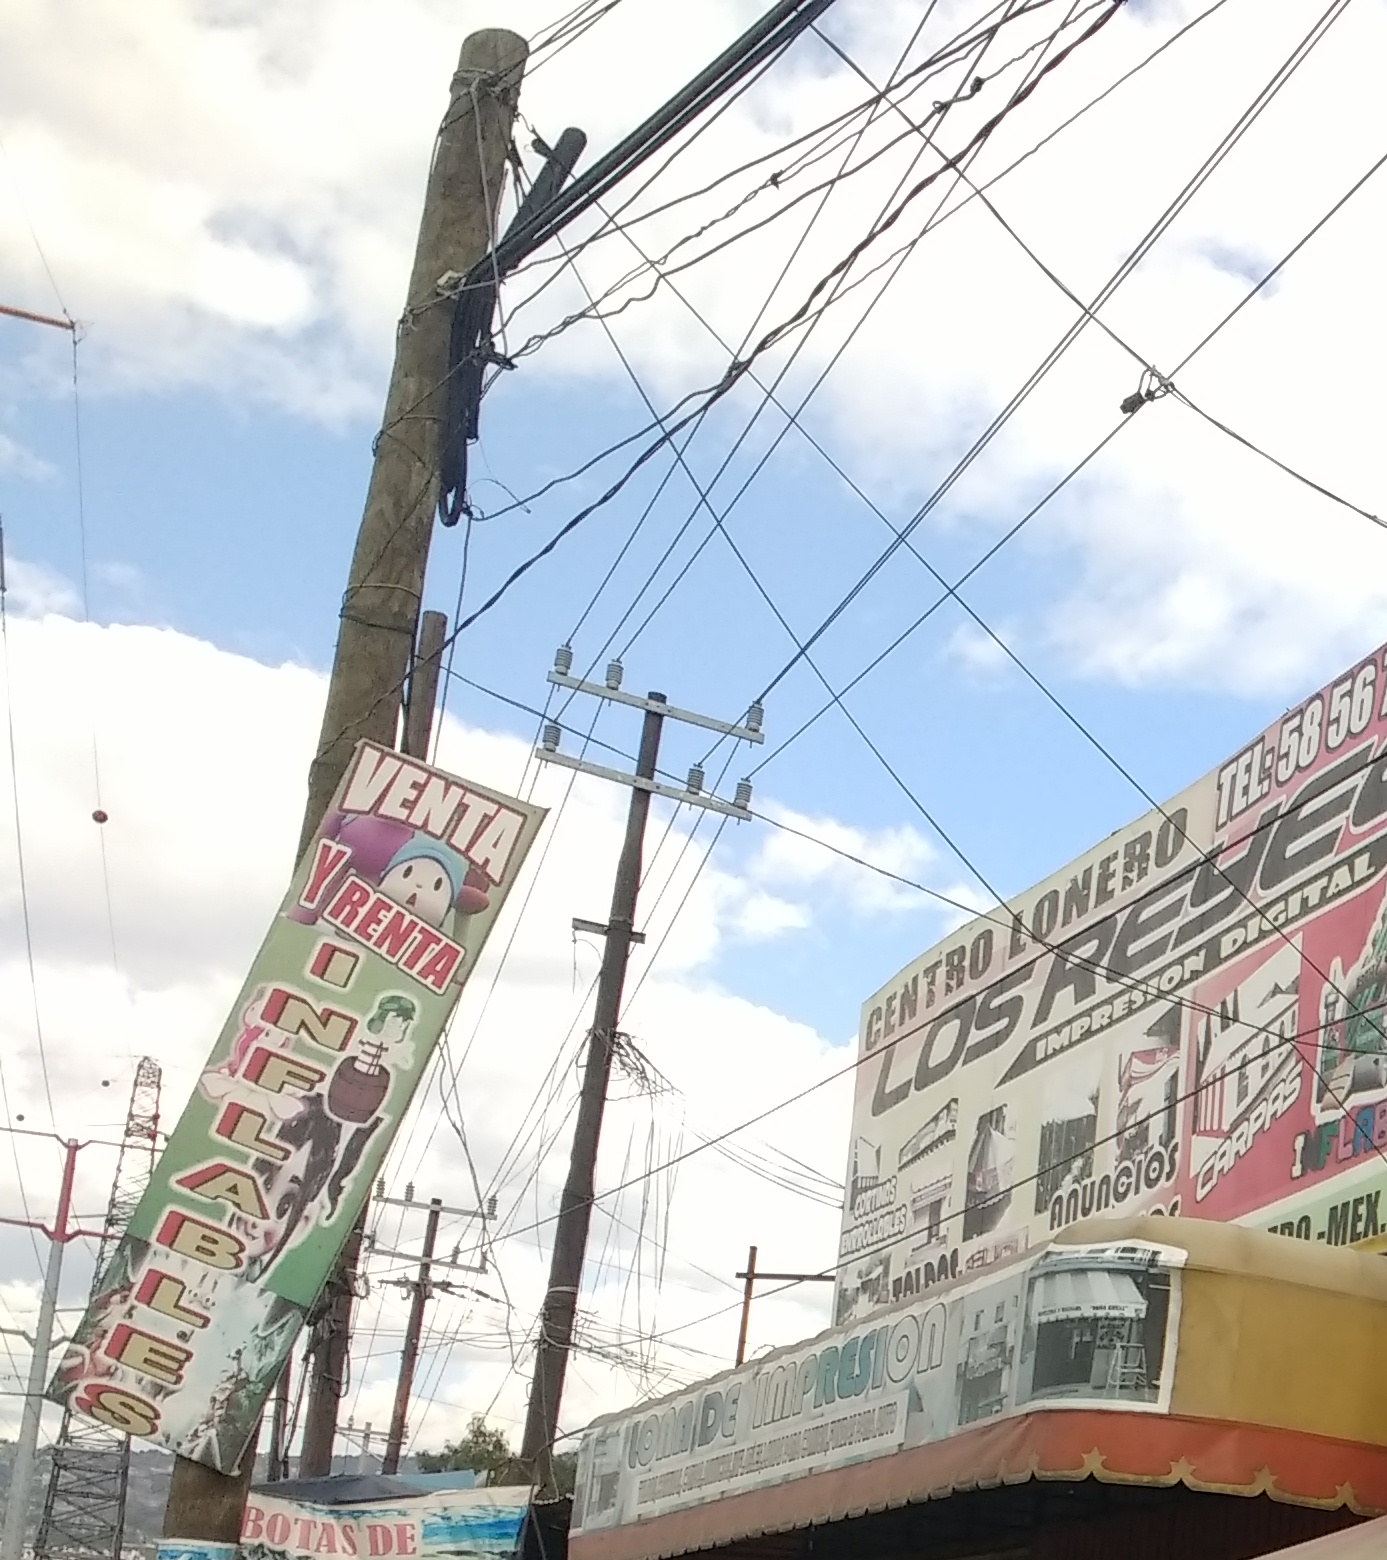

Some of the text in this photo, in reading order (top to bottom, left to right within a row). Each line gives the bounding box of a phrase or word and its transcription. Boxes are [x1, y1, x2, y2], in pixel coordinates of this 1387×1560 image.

[339, 741, 527, 887] VENTA
[1216, 736, 1275, 832] TEL:
[1276, 692, 1324, 788] 58
[1326, 657, 1378, 752] 56
[299, 838, 351, 911] Y
[323, 874, 466, 996] RENTA
[865, 806, 1189, 1051] CENTRO LONERO
[1034, 853, 1376, 1062] IMPRESION DIGITAL
[872, 953, 1041, 1118] LOS
[75, 942, 360, 1437] INFLABLES
[1050, 1141, 1179, 1231] ANUNCIOS
[1196, 1060, 1304, 1204] CARPAS
[629, 1400, 694, 1469] LONA
[697, 1382, 742, 1448] DE
[752, 1303, 948, 1430] IMPRESION
[241, 1505, 418, 1557] BOTAS DE
